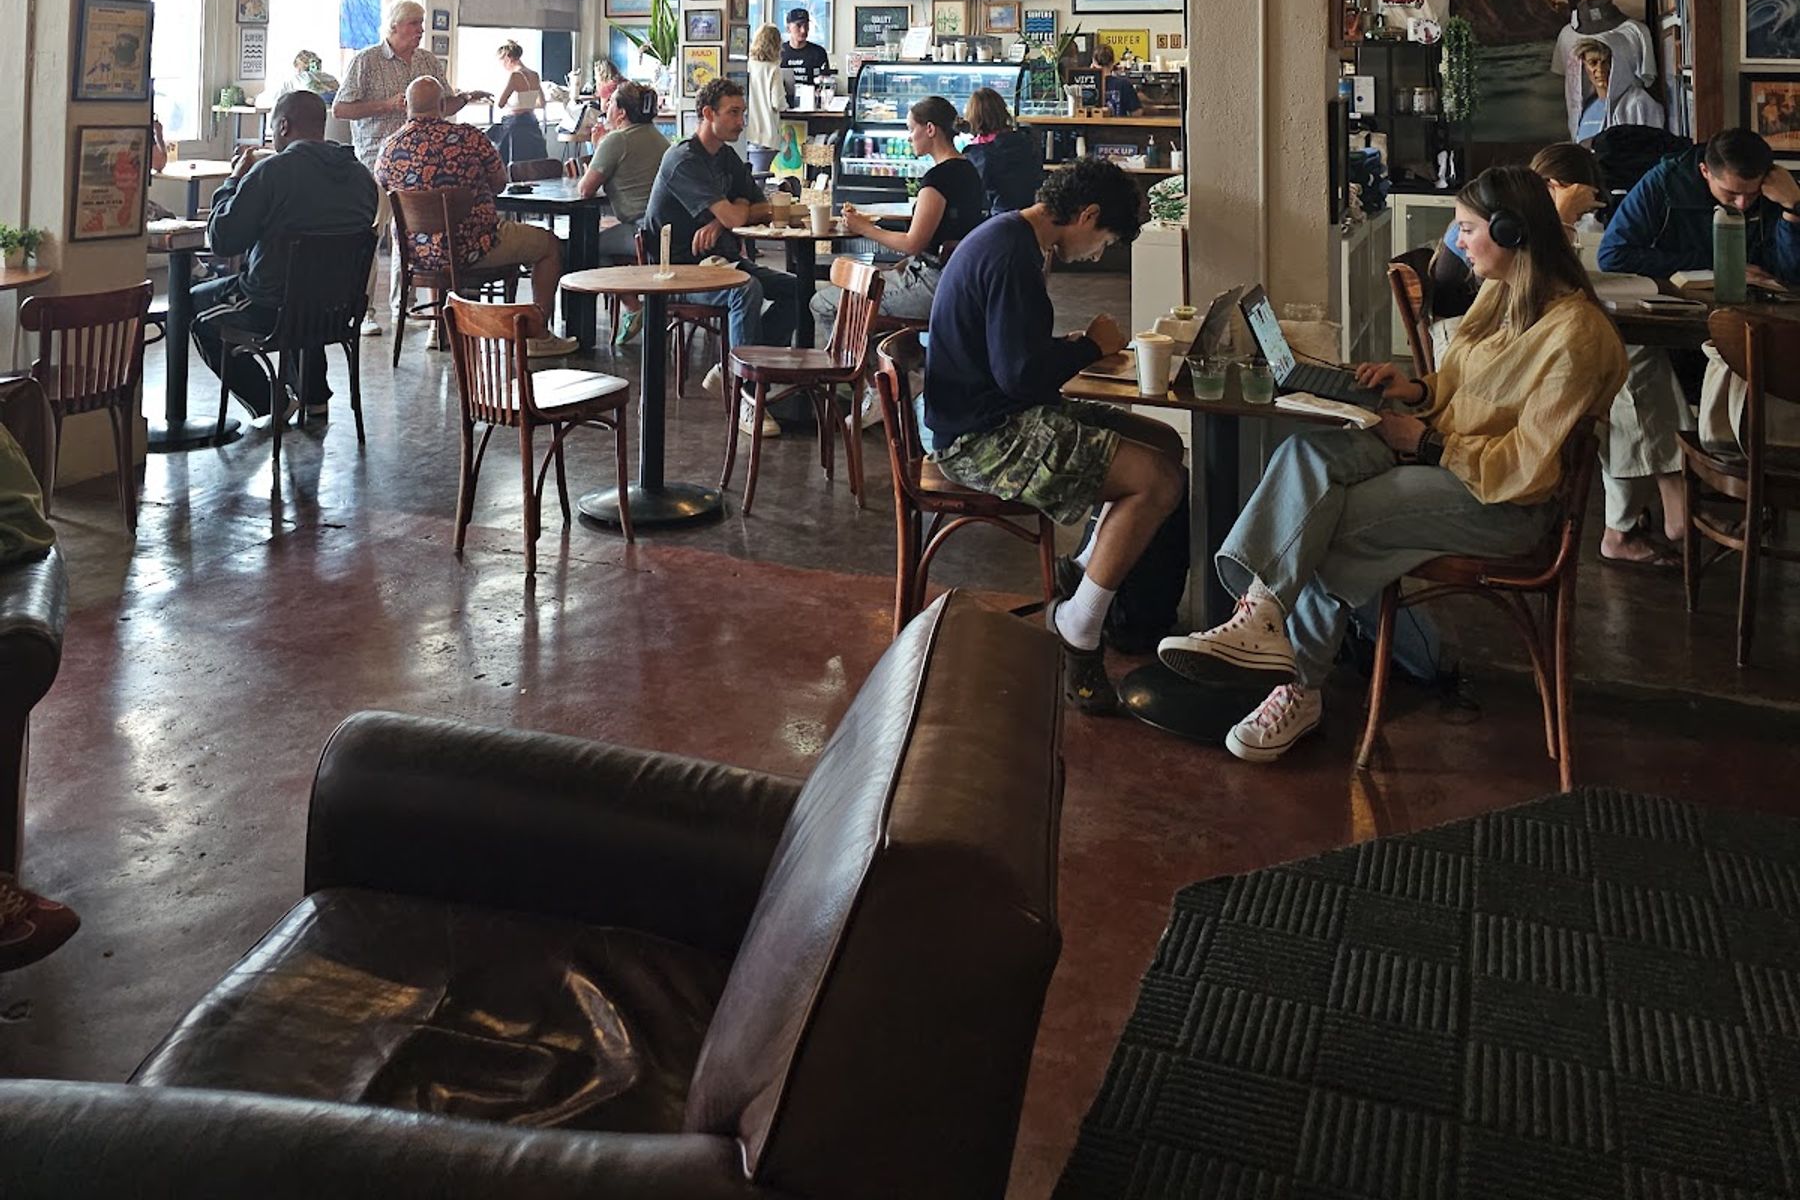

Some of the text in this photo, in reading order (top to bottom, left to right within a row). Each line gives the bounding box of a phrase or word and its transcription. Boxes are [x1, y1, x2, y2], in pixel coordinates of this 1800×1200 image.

[1027, 10, 1053, 18] SURFERS
[1105, 35, 1140, 45] SURFER
[243, 60, 263, 69] COFFEE
[1098, 146, 1134, 156] PICK UP
